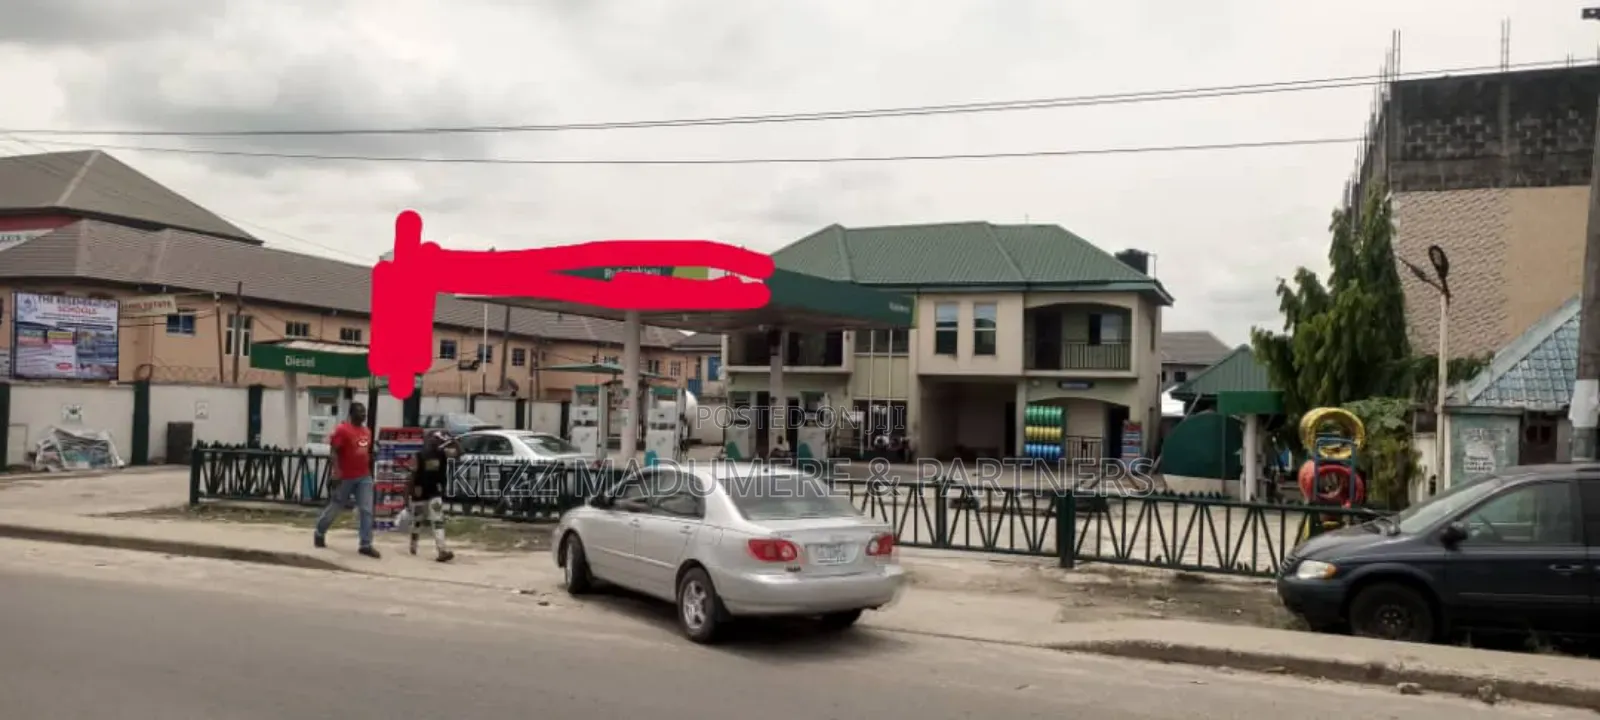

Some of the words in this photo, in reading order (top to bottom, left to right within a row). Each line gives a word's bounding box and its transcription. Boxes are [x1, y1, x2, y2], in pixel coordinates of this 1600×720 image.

[38, 294, 53, 304] THE
[56, 295, 117, 309] REGENERATION
[57, 306, 97, 316] SCHOOLS
[285, 355, 315, 368] Diesel
